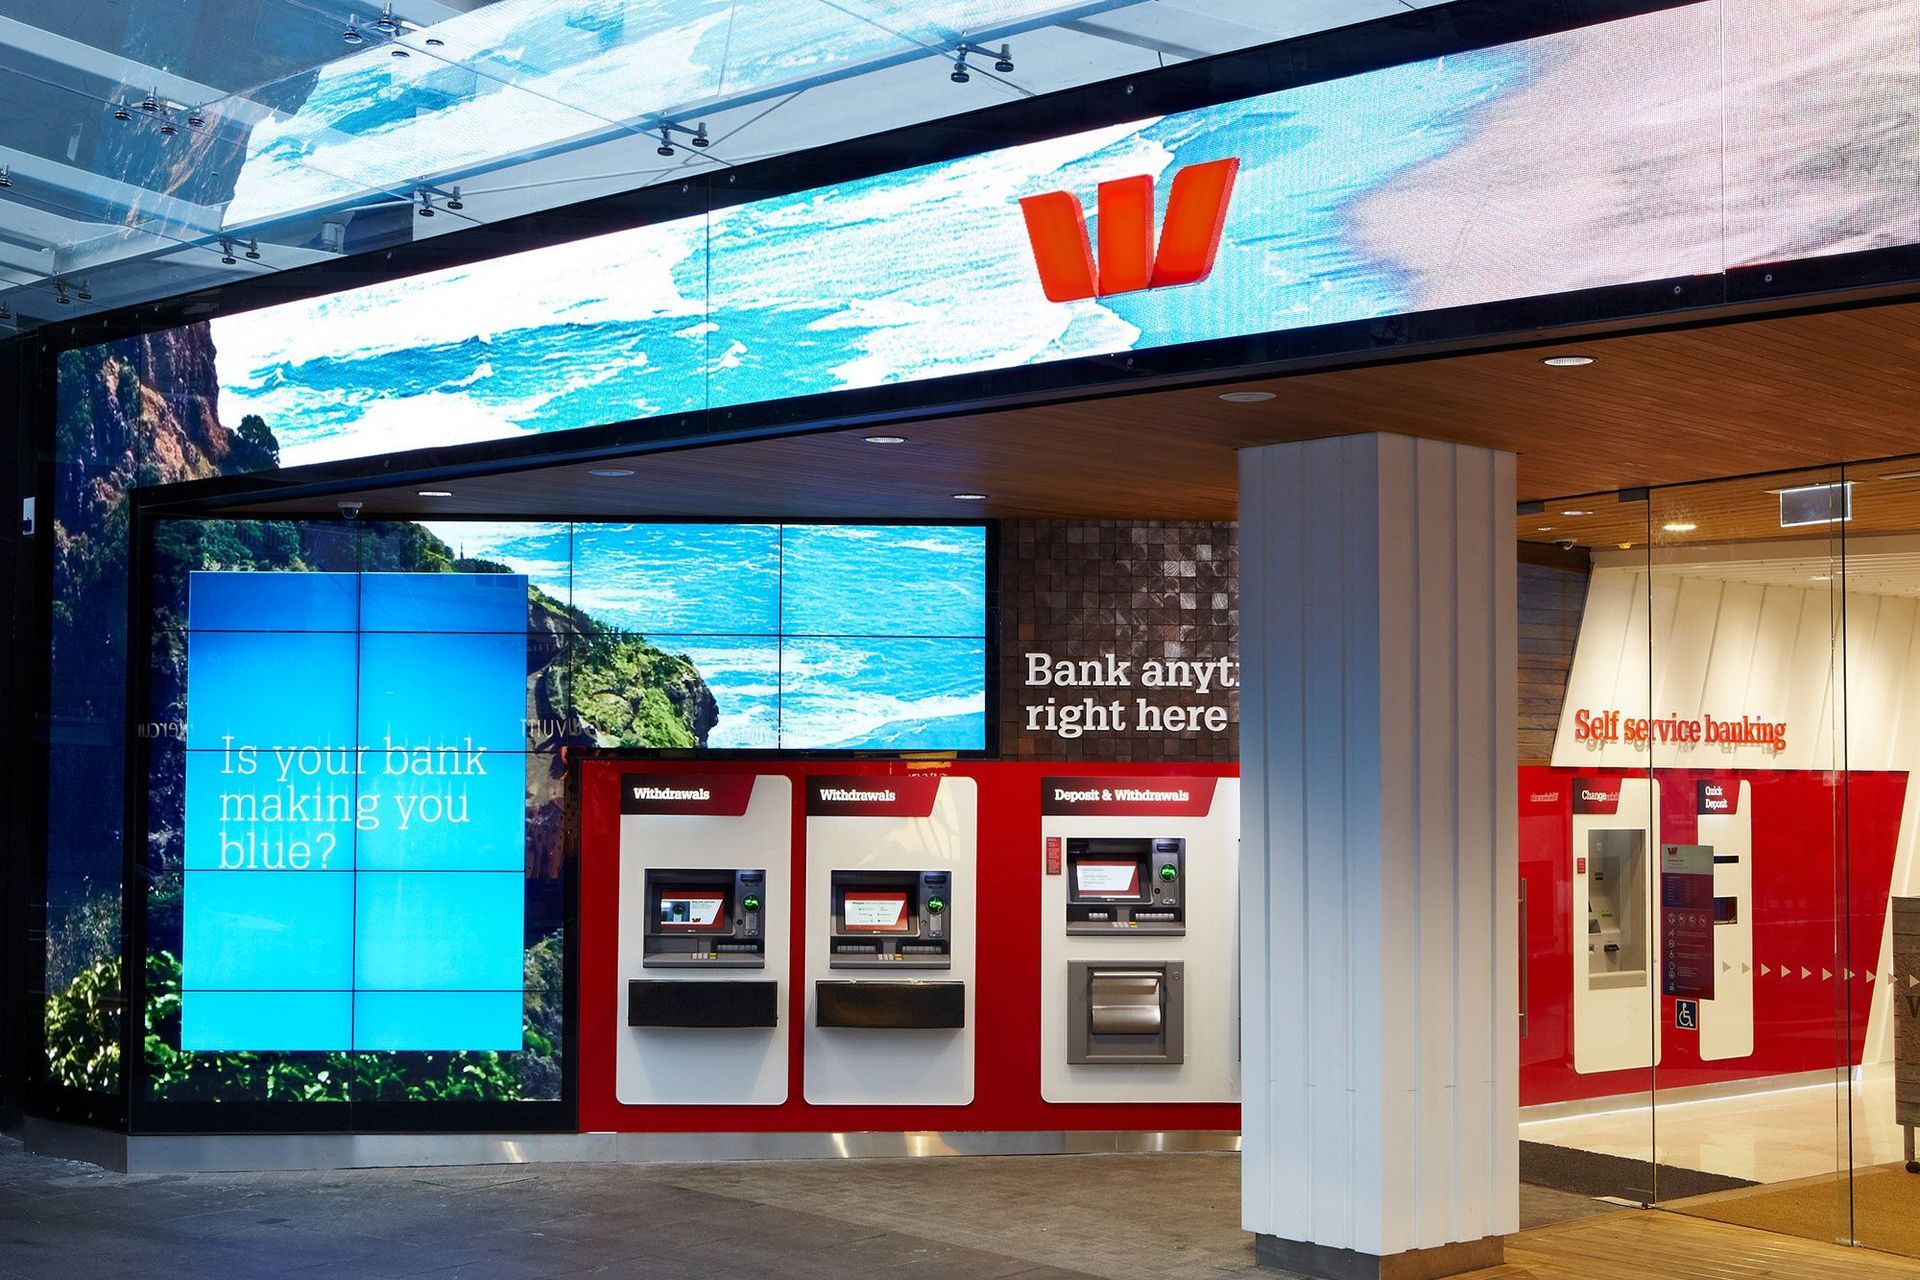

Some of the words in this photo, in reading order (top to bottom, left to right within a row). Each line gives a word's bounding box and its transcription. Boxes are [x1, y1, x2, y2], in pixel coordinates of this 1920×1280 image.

[1025, 653, 1131, 686] Bank
[1141, 656, 1239, 694] anyt
[1026, 698, 1126, 738] right
[1136, 698, 1228, 732] here
[1574, 709, 1620, 741] Self
[1623, 713, 1700, 743] service
[1704, 714, 1787, 751] banking
[220, 736, 257, 775] Is
[272, 745, 369, 782] your
[383, 736, 488, 776] bank
[633, 787, 710, 800] Withdrawals
[819, 788, 896, 802] Withdrawals
[1054, 788, 1100, 803] Deposit
[1101, 789, 1112, 801] &
[1114, 789, 1189, 802] Withdrawals
[1581, 790, 1606, 802] Change
[1705, 785, 1723, 796] Quick
[219, 785, 381, 830] making
[394, 795, 470, 830] you
[1705, 798, 1728, 810] Deposit
[218, 832, 337, 870] blue?
